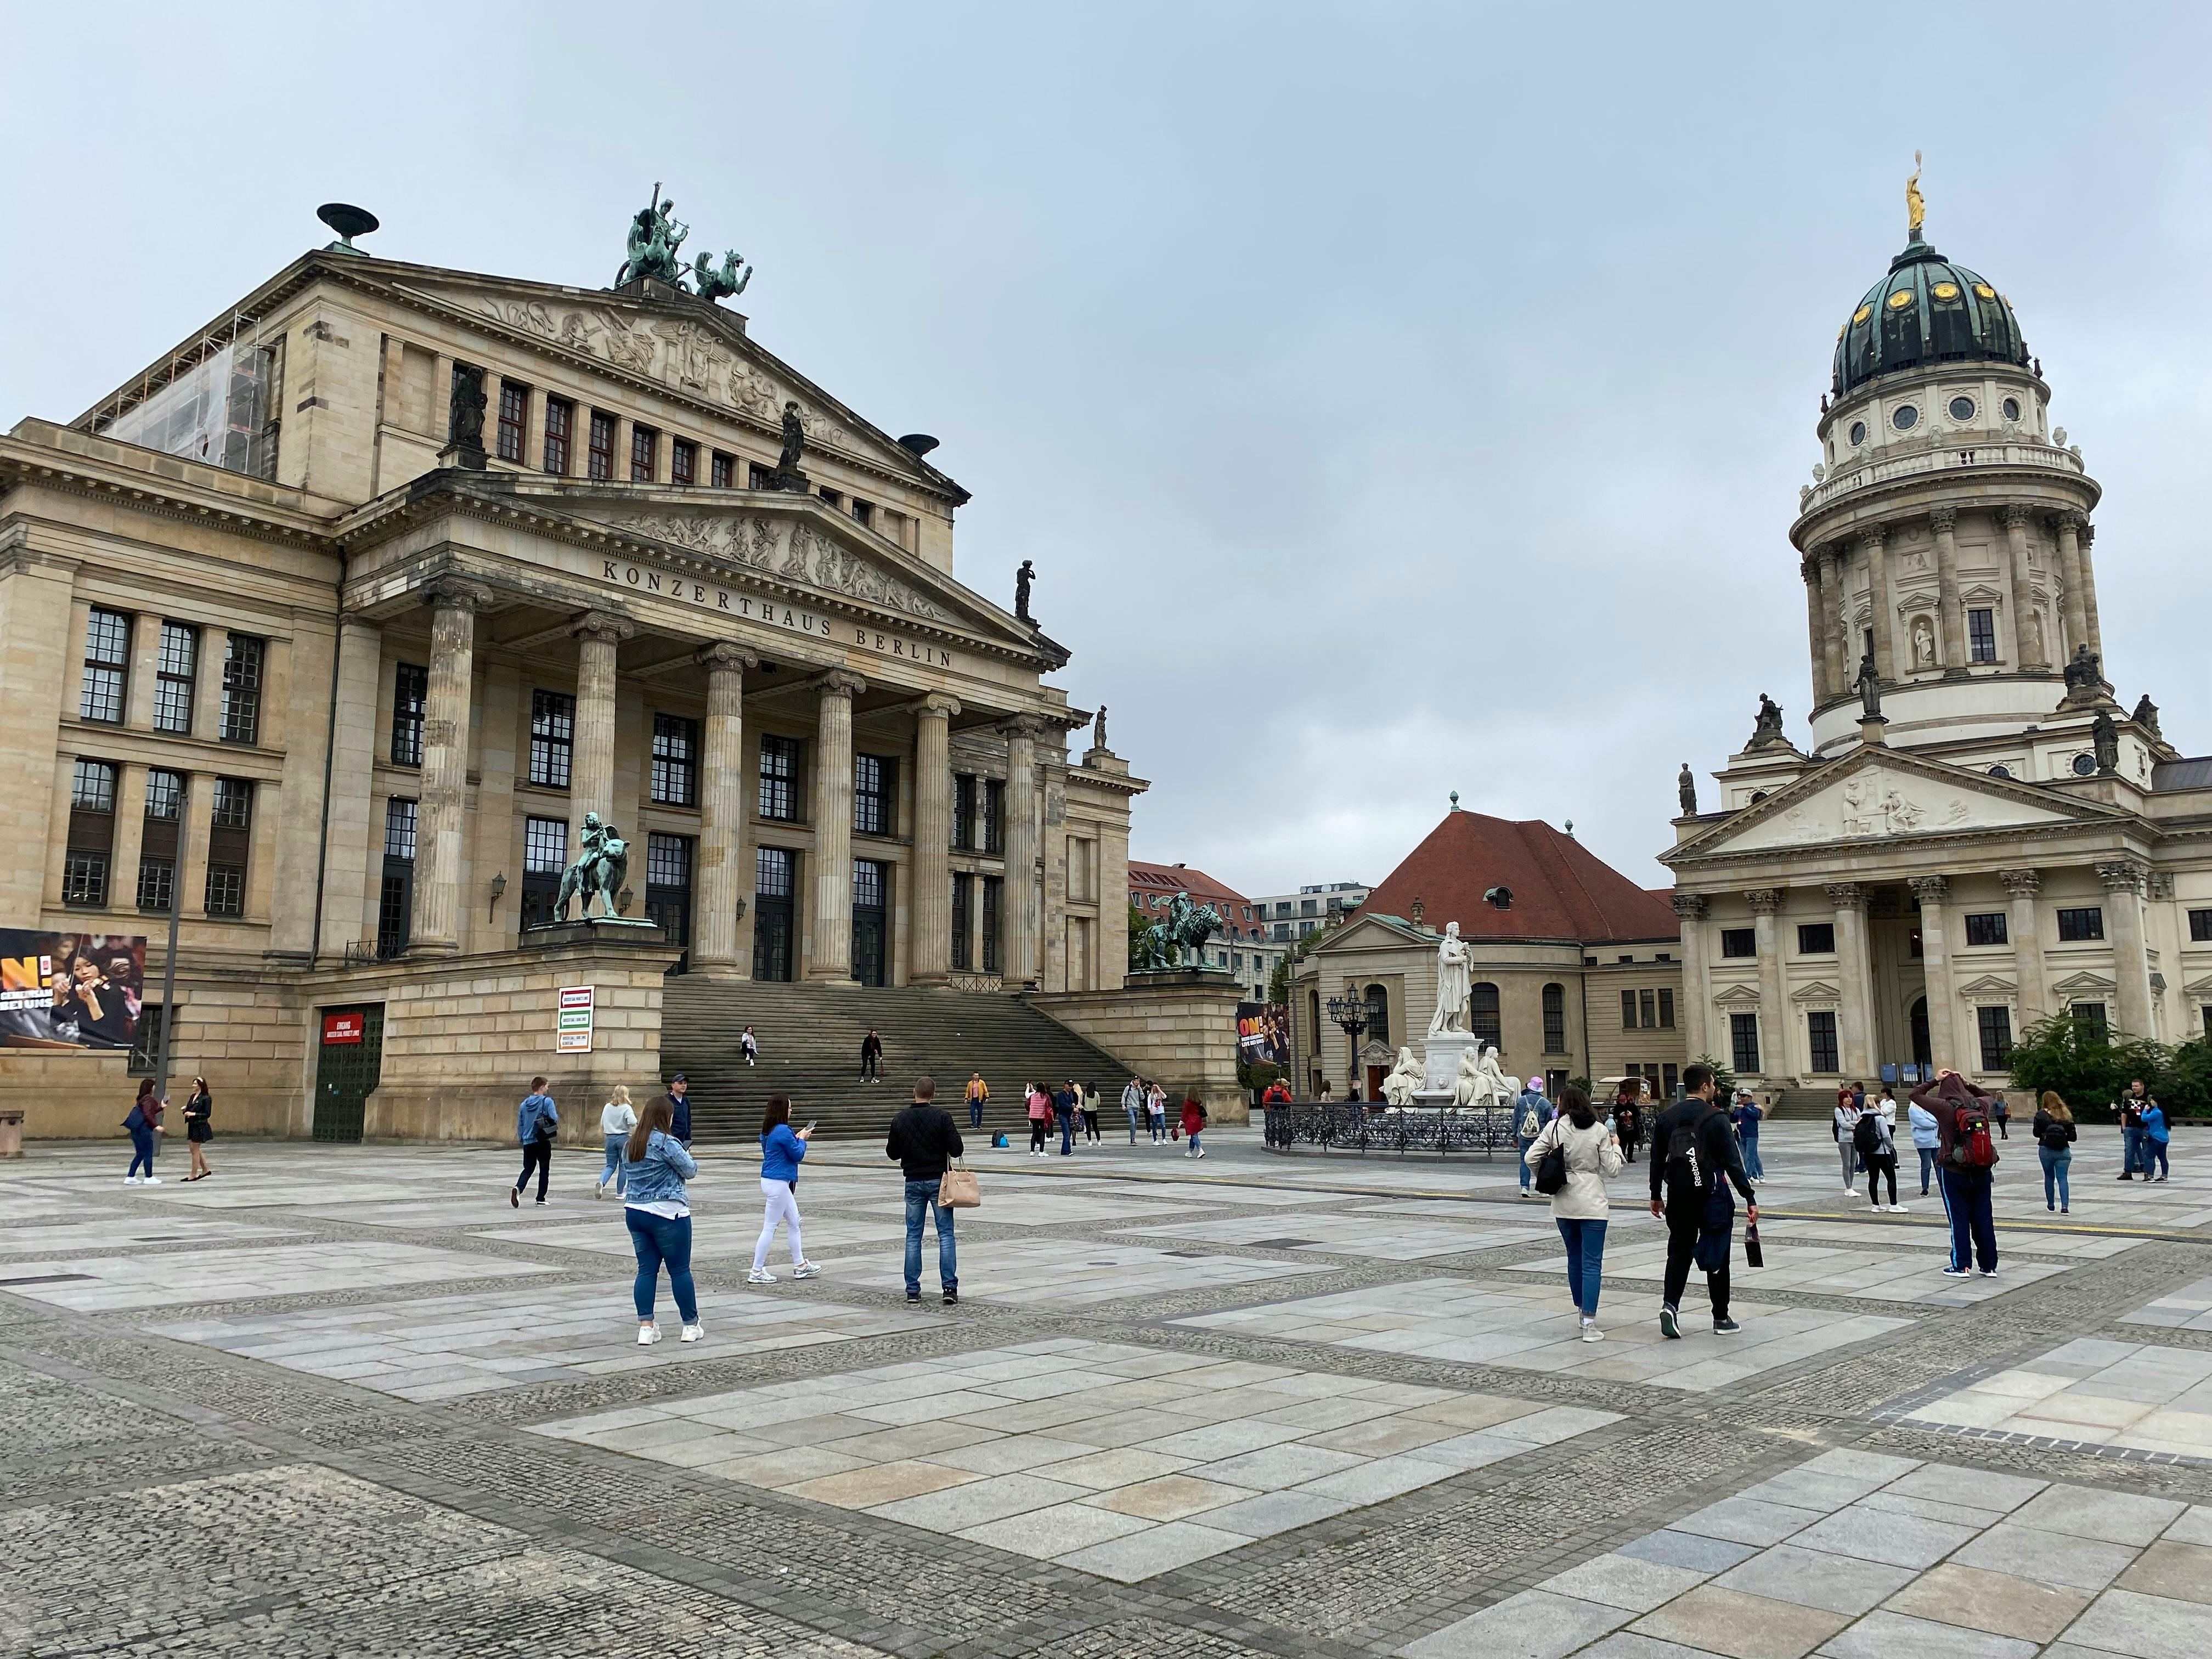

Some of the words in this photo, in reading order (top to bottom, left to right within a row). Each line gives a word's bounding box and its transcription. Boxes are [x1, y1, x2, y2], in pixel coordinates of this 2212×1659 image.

[603, 560, 830, 635] KONZERTHAUS
[856, 629, 951, 667] BERLIN
[24, 998, 54, 1009] UNS
[1239, 1015, 1263, 1036] ON!
[1689, 1156, 1702, 1187] Reebok
